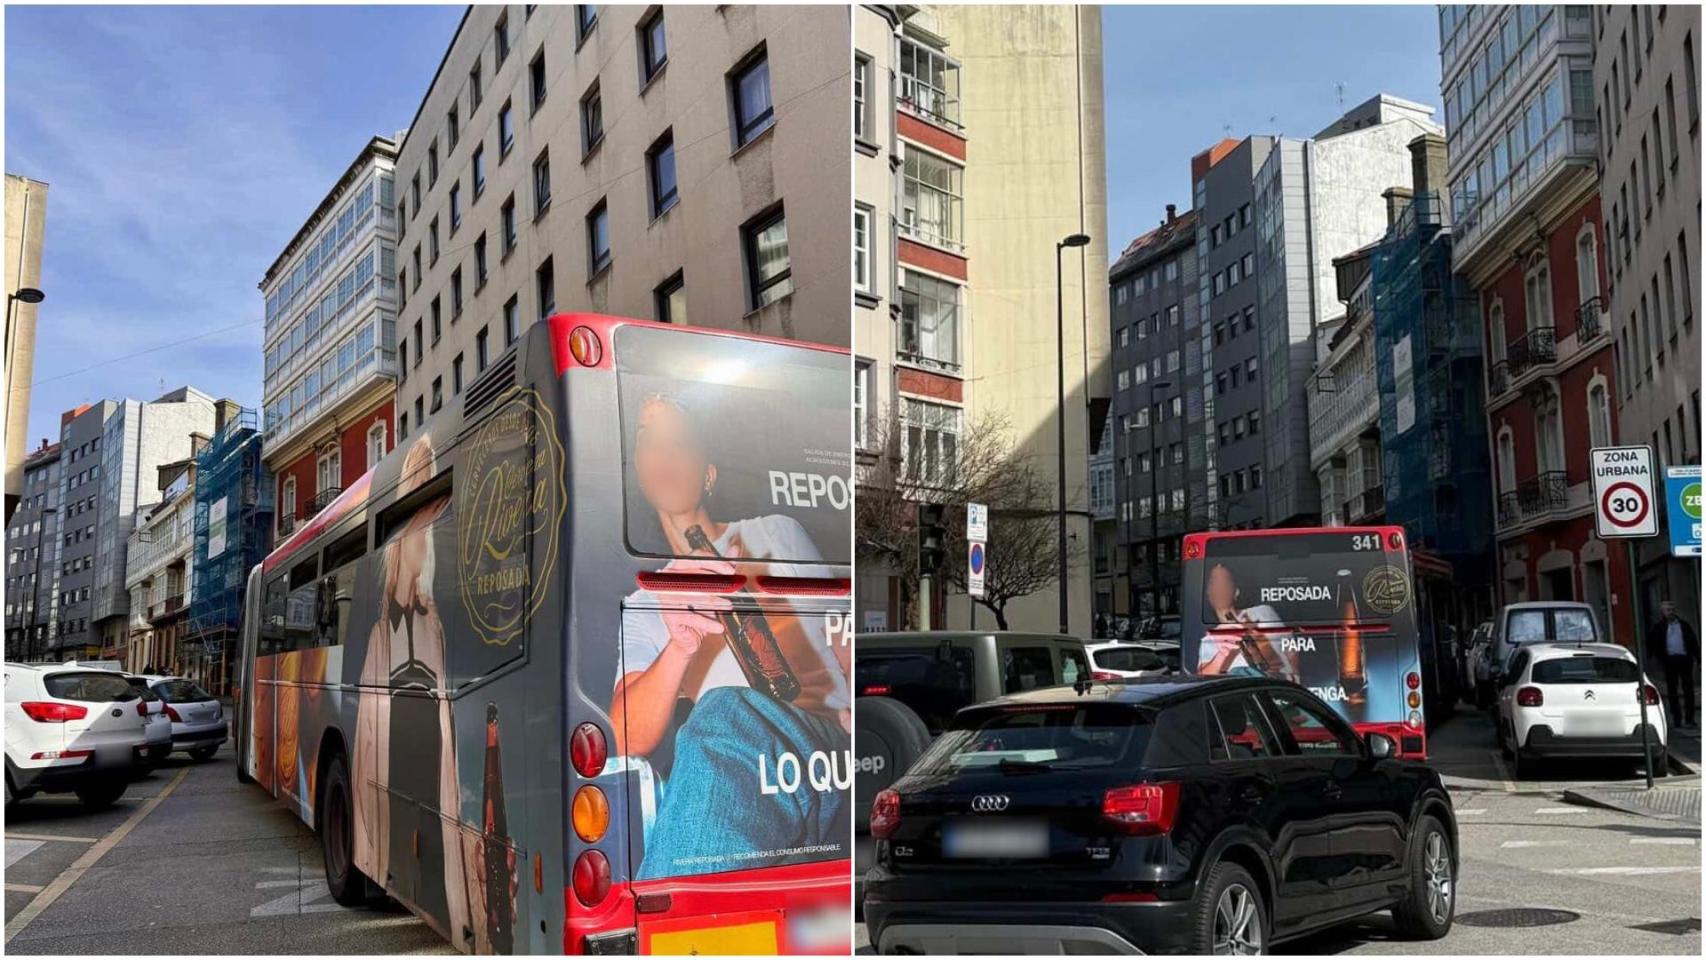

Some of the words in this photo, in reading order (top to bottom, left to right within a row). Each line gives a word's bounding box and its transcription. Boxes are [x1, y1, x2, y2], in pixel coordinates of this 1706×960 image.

[1603, 451, 1638, 462] ZONA
[1597, 465, 1648, 477] URBANA
[768, 470, 851, 511] REPO
[1612, 497, 1639, 513] 30
[1352, 534, 1380, 550] 341
[478, 564, 531, 596] REPOSADA
[1260, 586, 1331, 602] REPOSADA
[1281, 637, 1316, 652] PARA
[758, 751, 801, 795] LO
